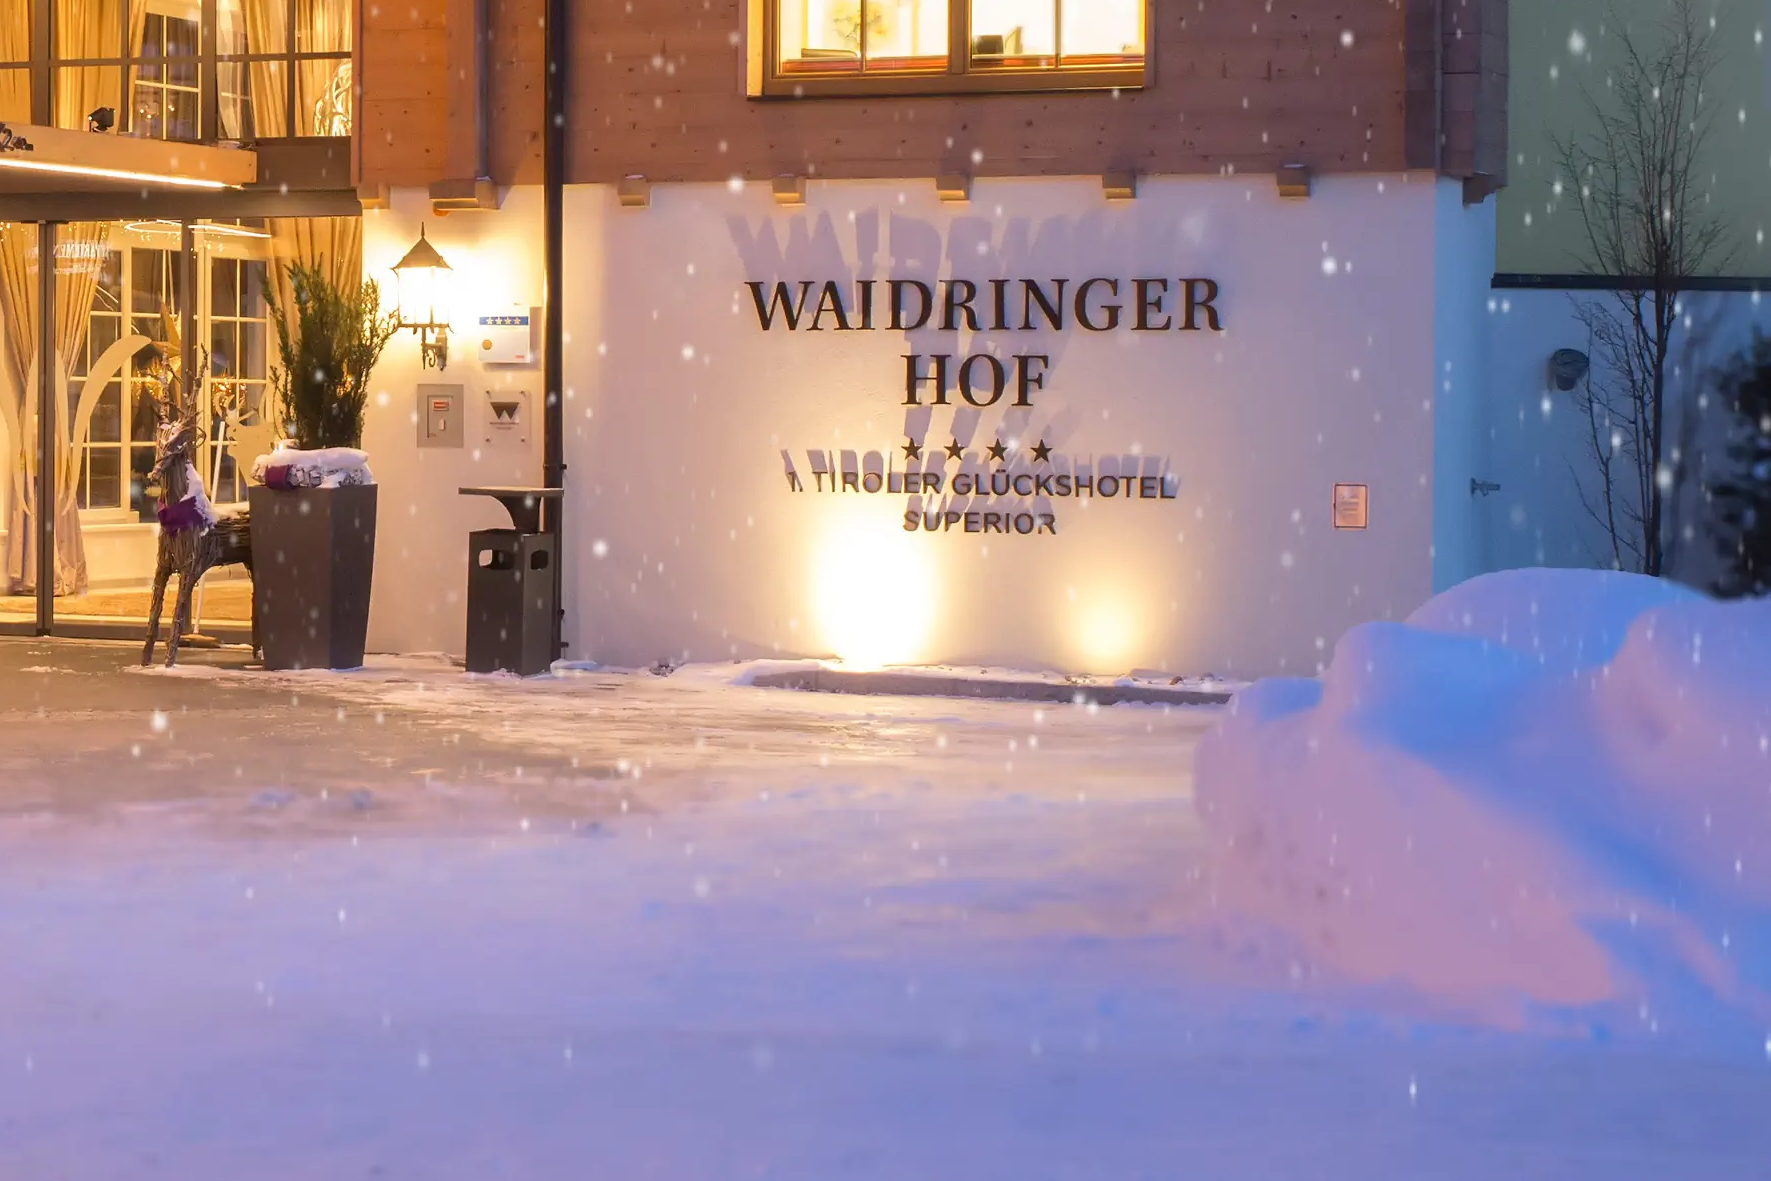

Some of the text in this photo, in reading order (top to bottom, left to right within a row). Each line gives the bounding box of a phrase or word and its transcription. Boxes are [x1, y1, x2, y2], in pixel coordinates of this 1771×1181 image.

[743, 277, 1225, 332] WAIDRINGER
[899, 353, 1049, 407] HOF
[811, 471, 941, 494] TIROLER
[951, 468, 1177, 499] GLÜCKSHOTEL
[902, 510, 1057, 535] SUPERIOR
